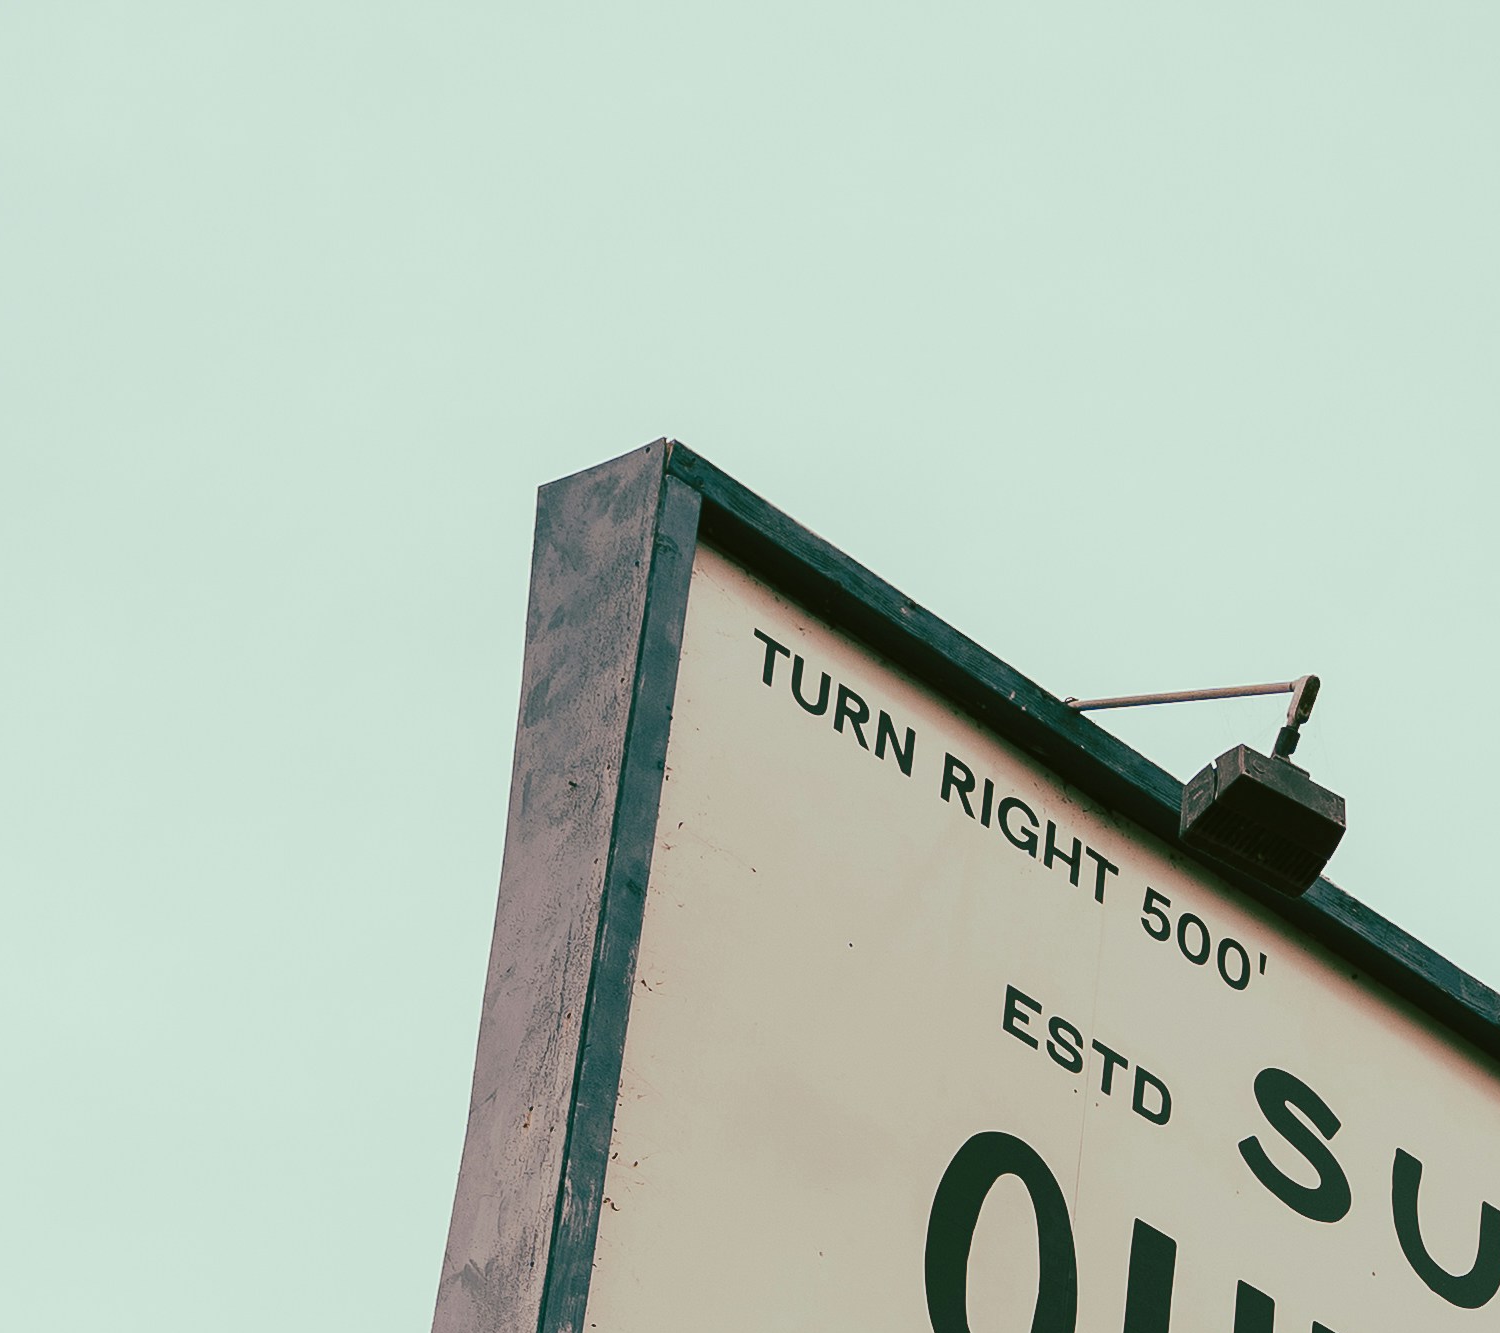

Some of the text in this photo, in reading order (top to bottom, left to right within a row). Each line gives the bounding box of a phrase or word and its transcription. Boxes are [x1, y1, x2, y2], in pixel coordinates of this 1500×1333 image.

[752, 626, 1269, 992] TURN RIGHT 500'
[1001, 982, 1173, 1127] ESTD
